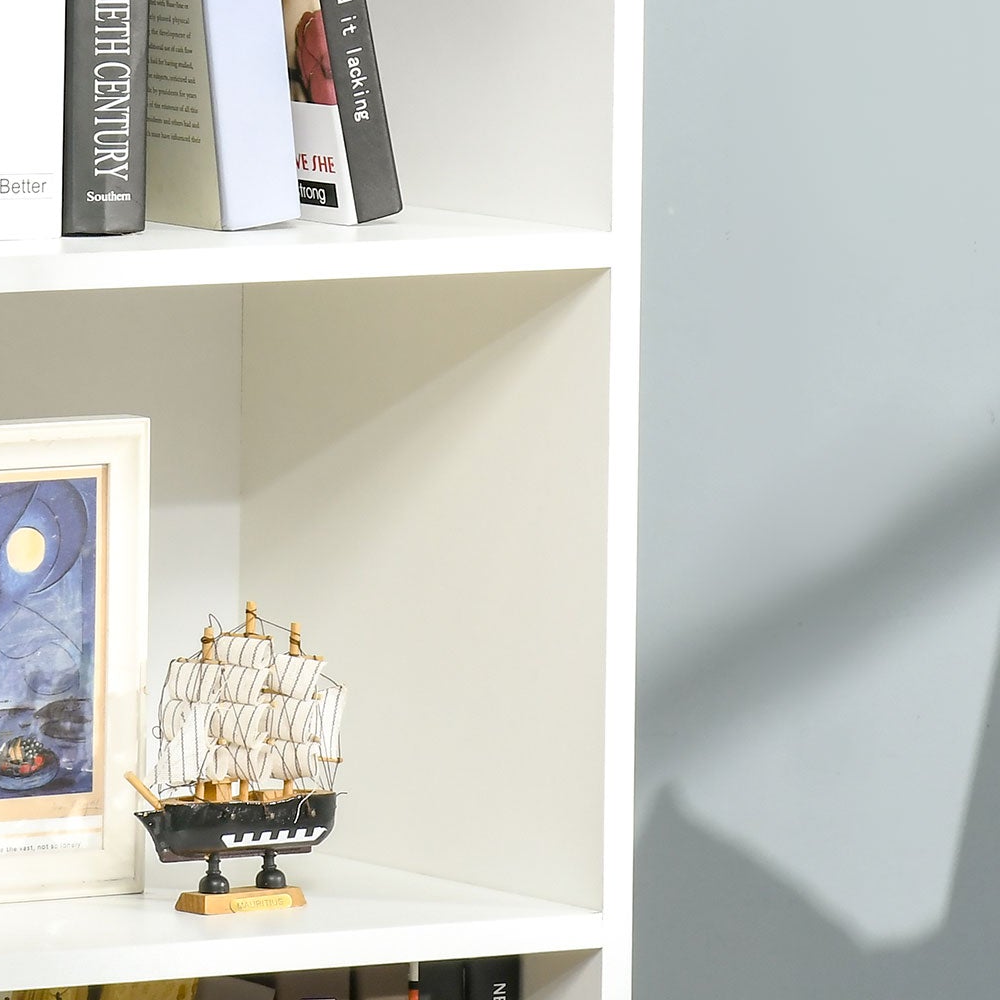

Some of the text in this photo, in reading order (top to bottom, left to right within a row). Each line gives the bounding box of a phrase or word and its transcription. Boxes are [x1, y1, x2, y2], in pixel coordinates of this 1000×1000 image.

[341, 15, 357, 36] it
[346, 47, 371, 122] lacking
[94, 62, 131, 181] CENTURY
[312, 155, 336, 174] SHE
[0, 178, 47, 195] Better
[87, 190, 131, 202] Southern
